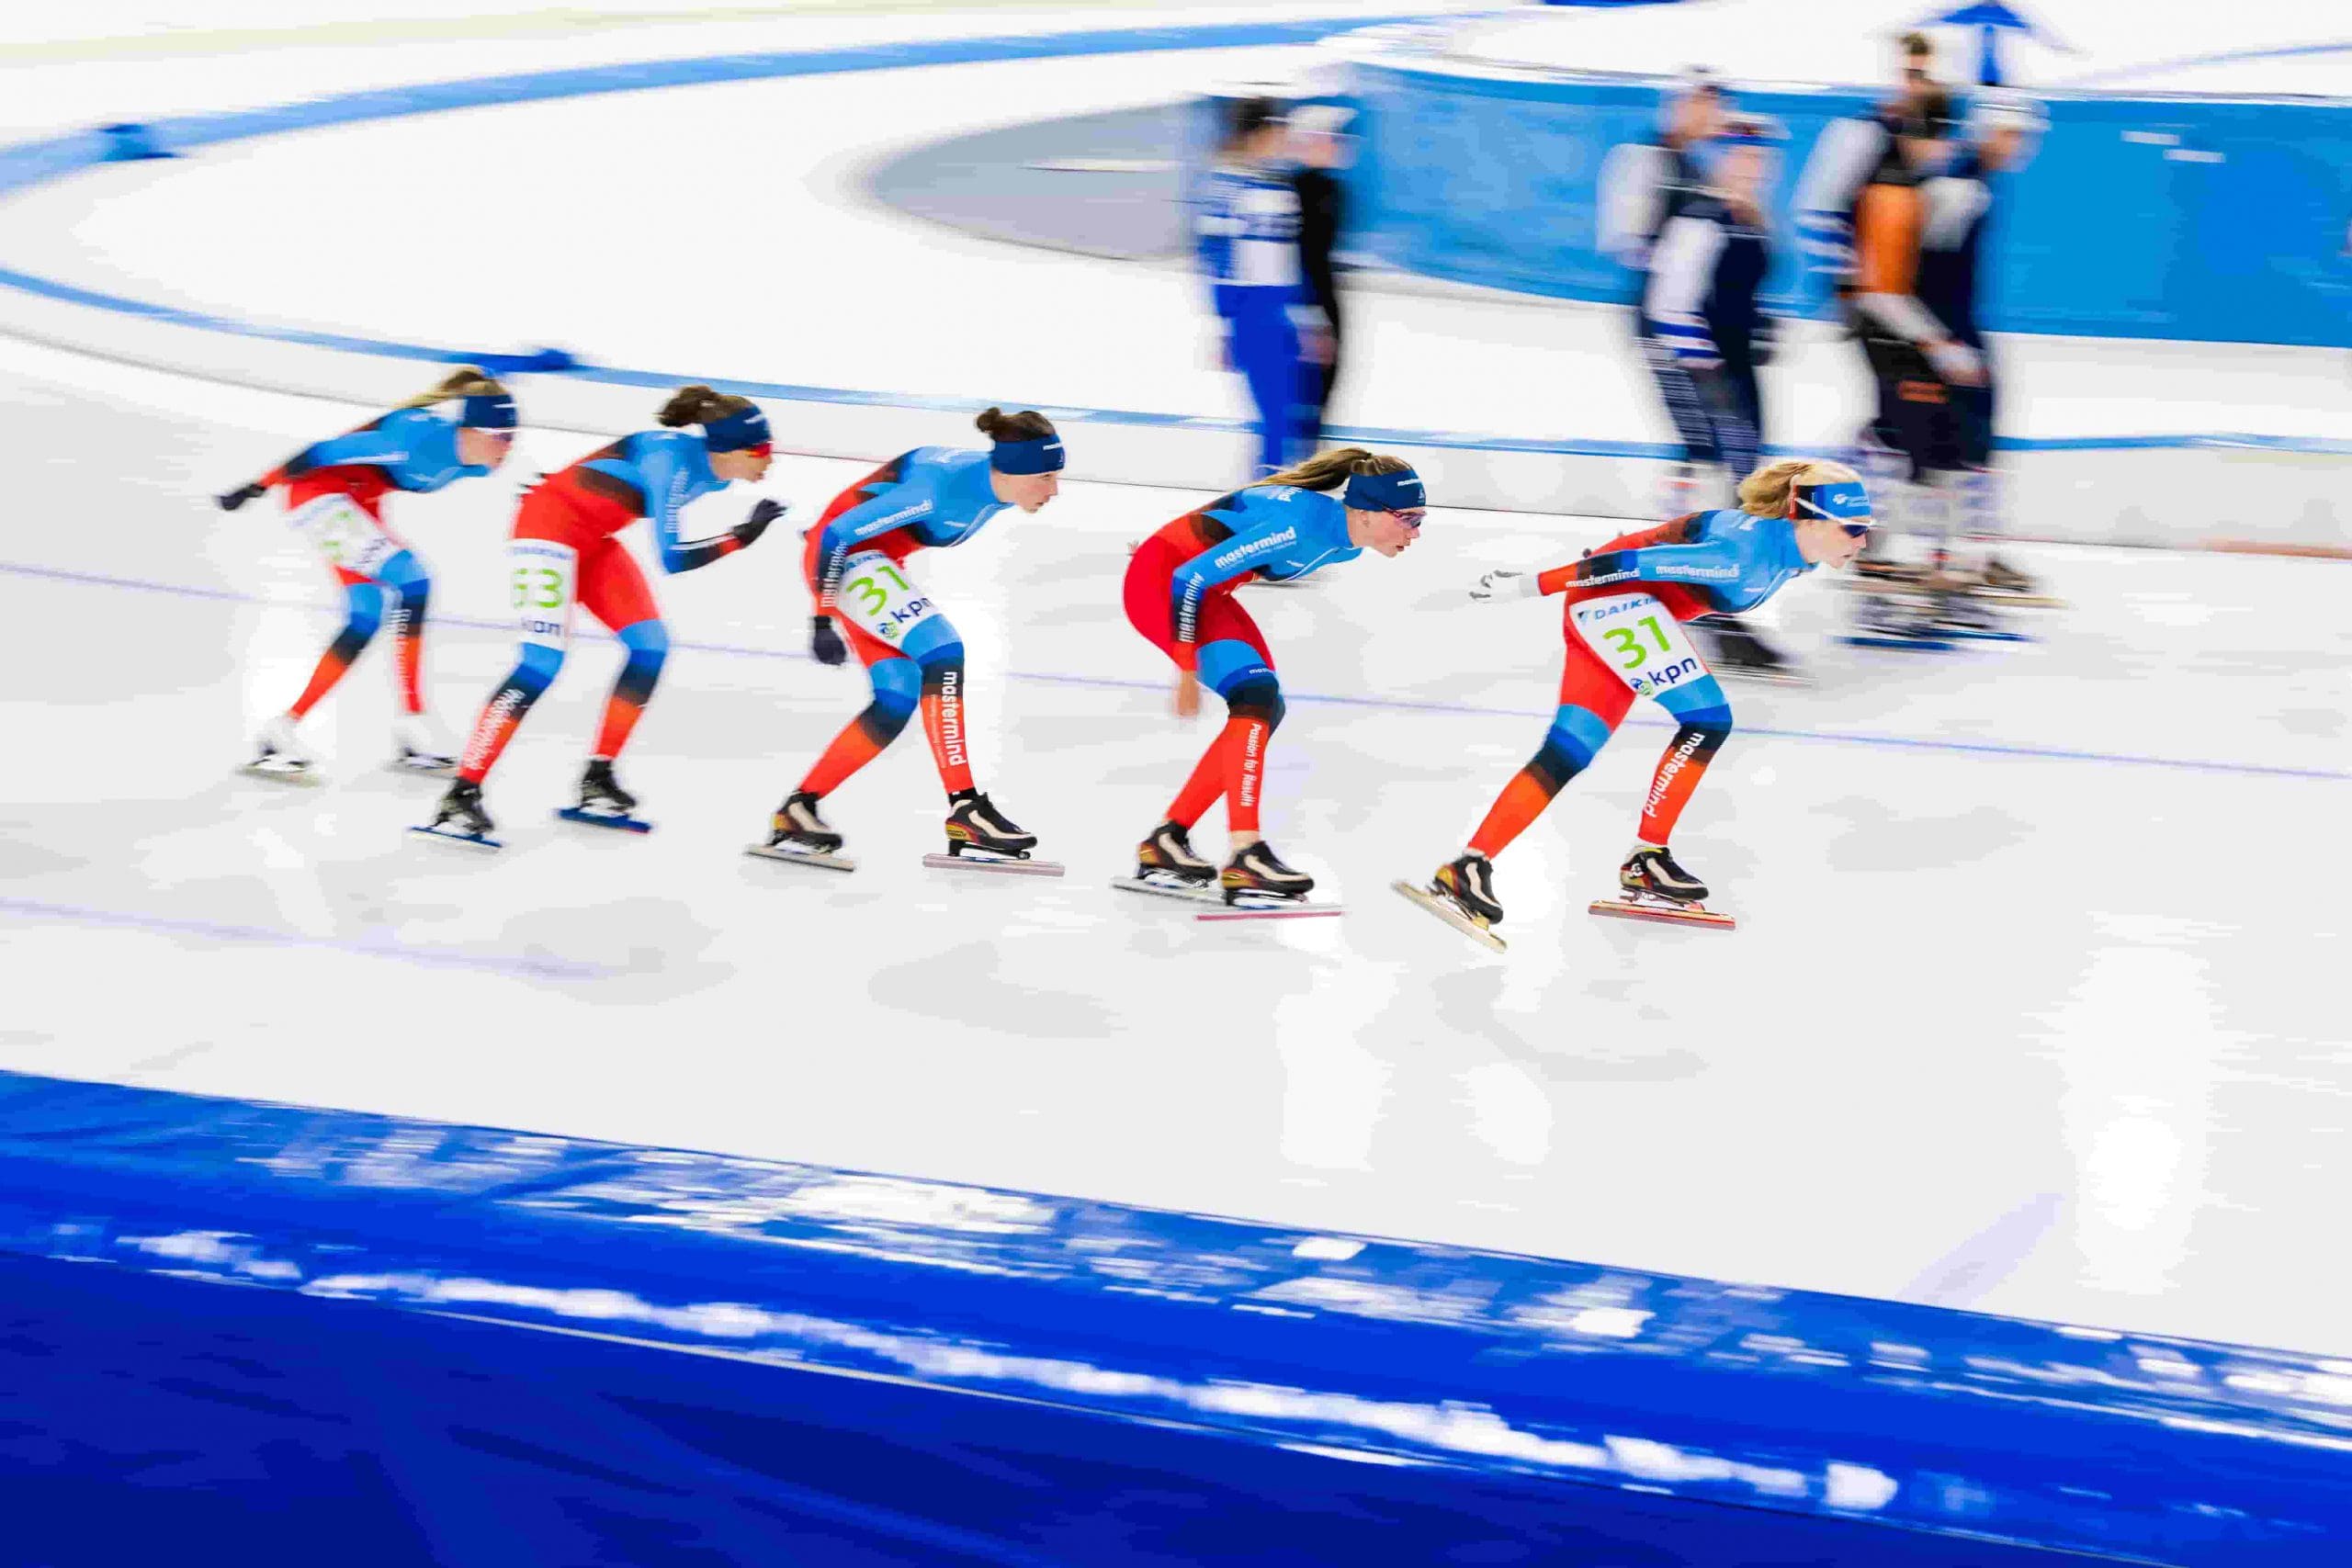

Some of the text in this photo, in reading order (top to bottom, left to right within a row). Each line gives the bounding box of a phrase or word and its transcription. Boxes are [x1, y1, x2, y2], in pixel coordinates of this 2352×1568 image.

[1215, 525, 1296, 569] mastermind
[846, 565, 910, 616] 31
[1566, 568, 1641, 589] mastermind
[1656, 563, 1740, 580] mastermind
[1602, 615, 1671, 669] 31
[1647, 657, 1698, 686] kpn
[942, 671, 967, 766] mastermind
[1245, 722, 1262, 757] Passion
[1243, 759, 1260, 773] for
[1644, 732, 1706, 818] mastermind
